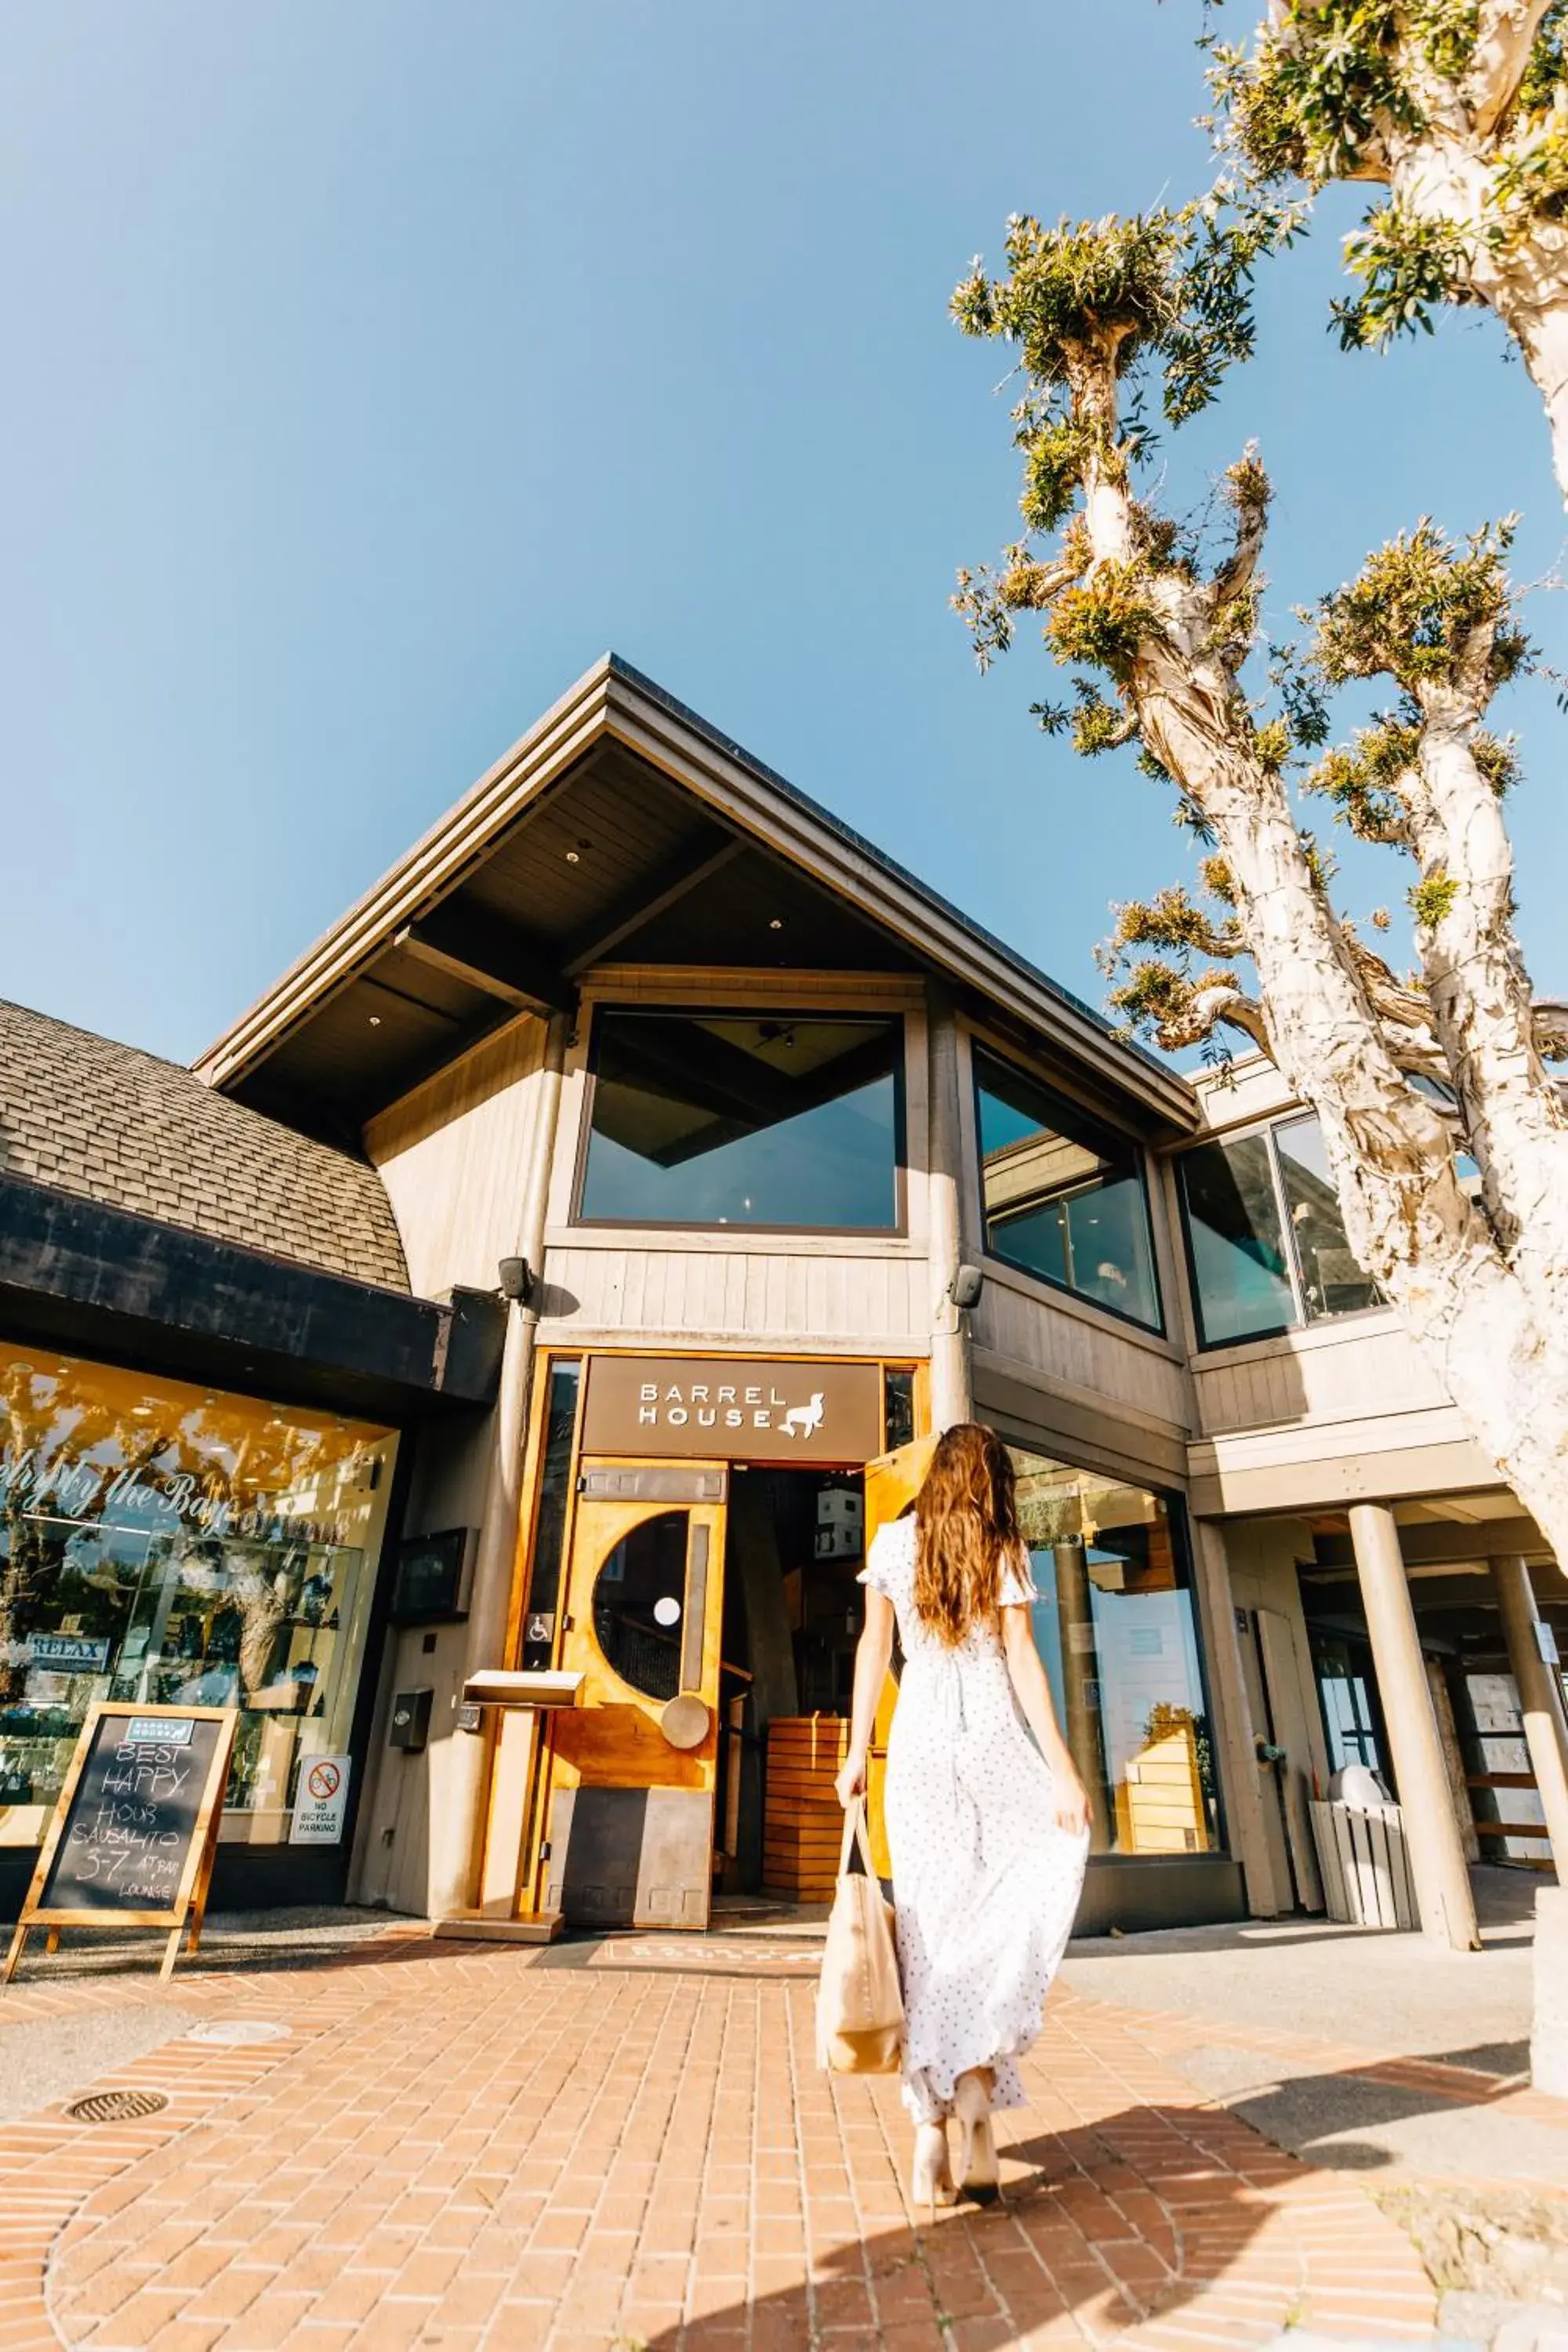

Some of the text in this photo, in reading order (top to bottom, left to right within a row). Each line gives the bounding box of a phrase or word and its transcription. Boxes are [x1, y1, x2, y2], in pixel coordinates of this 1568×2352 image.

[640, 1384, 786, 1405] BARREL
[638, 1406, 771, 1428] HOUSE
[60, 1459, 103, 1517] by
[104, 1468, 154, 1508] the
[158, 1473, 223, 1537] Bay
[34, 1638, 99, 1657] RELAX
[115, 1742, 191, 1763] BEST
[101, 1766, 190, 1801] HAPPY
[96, 1801, 158, 1827] HOUR
[300, 1812, 336, 1821] BICYCLE
[71, 1823, 180, 1849] SAUSALITO
[299, 1823, 336, 1832] PARKING
[76, 1848, 131, 1882] 3-7
[137, 1853, 158, 1871] AT
[118, 1882, 171, 1899] LOUNGE
